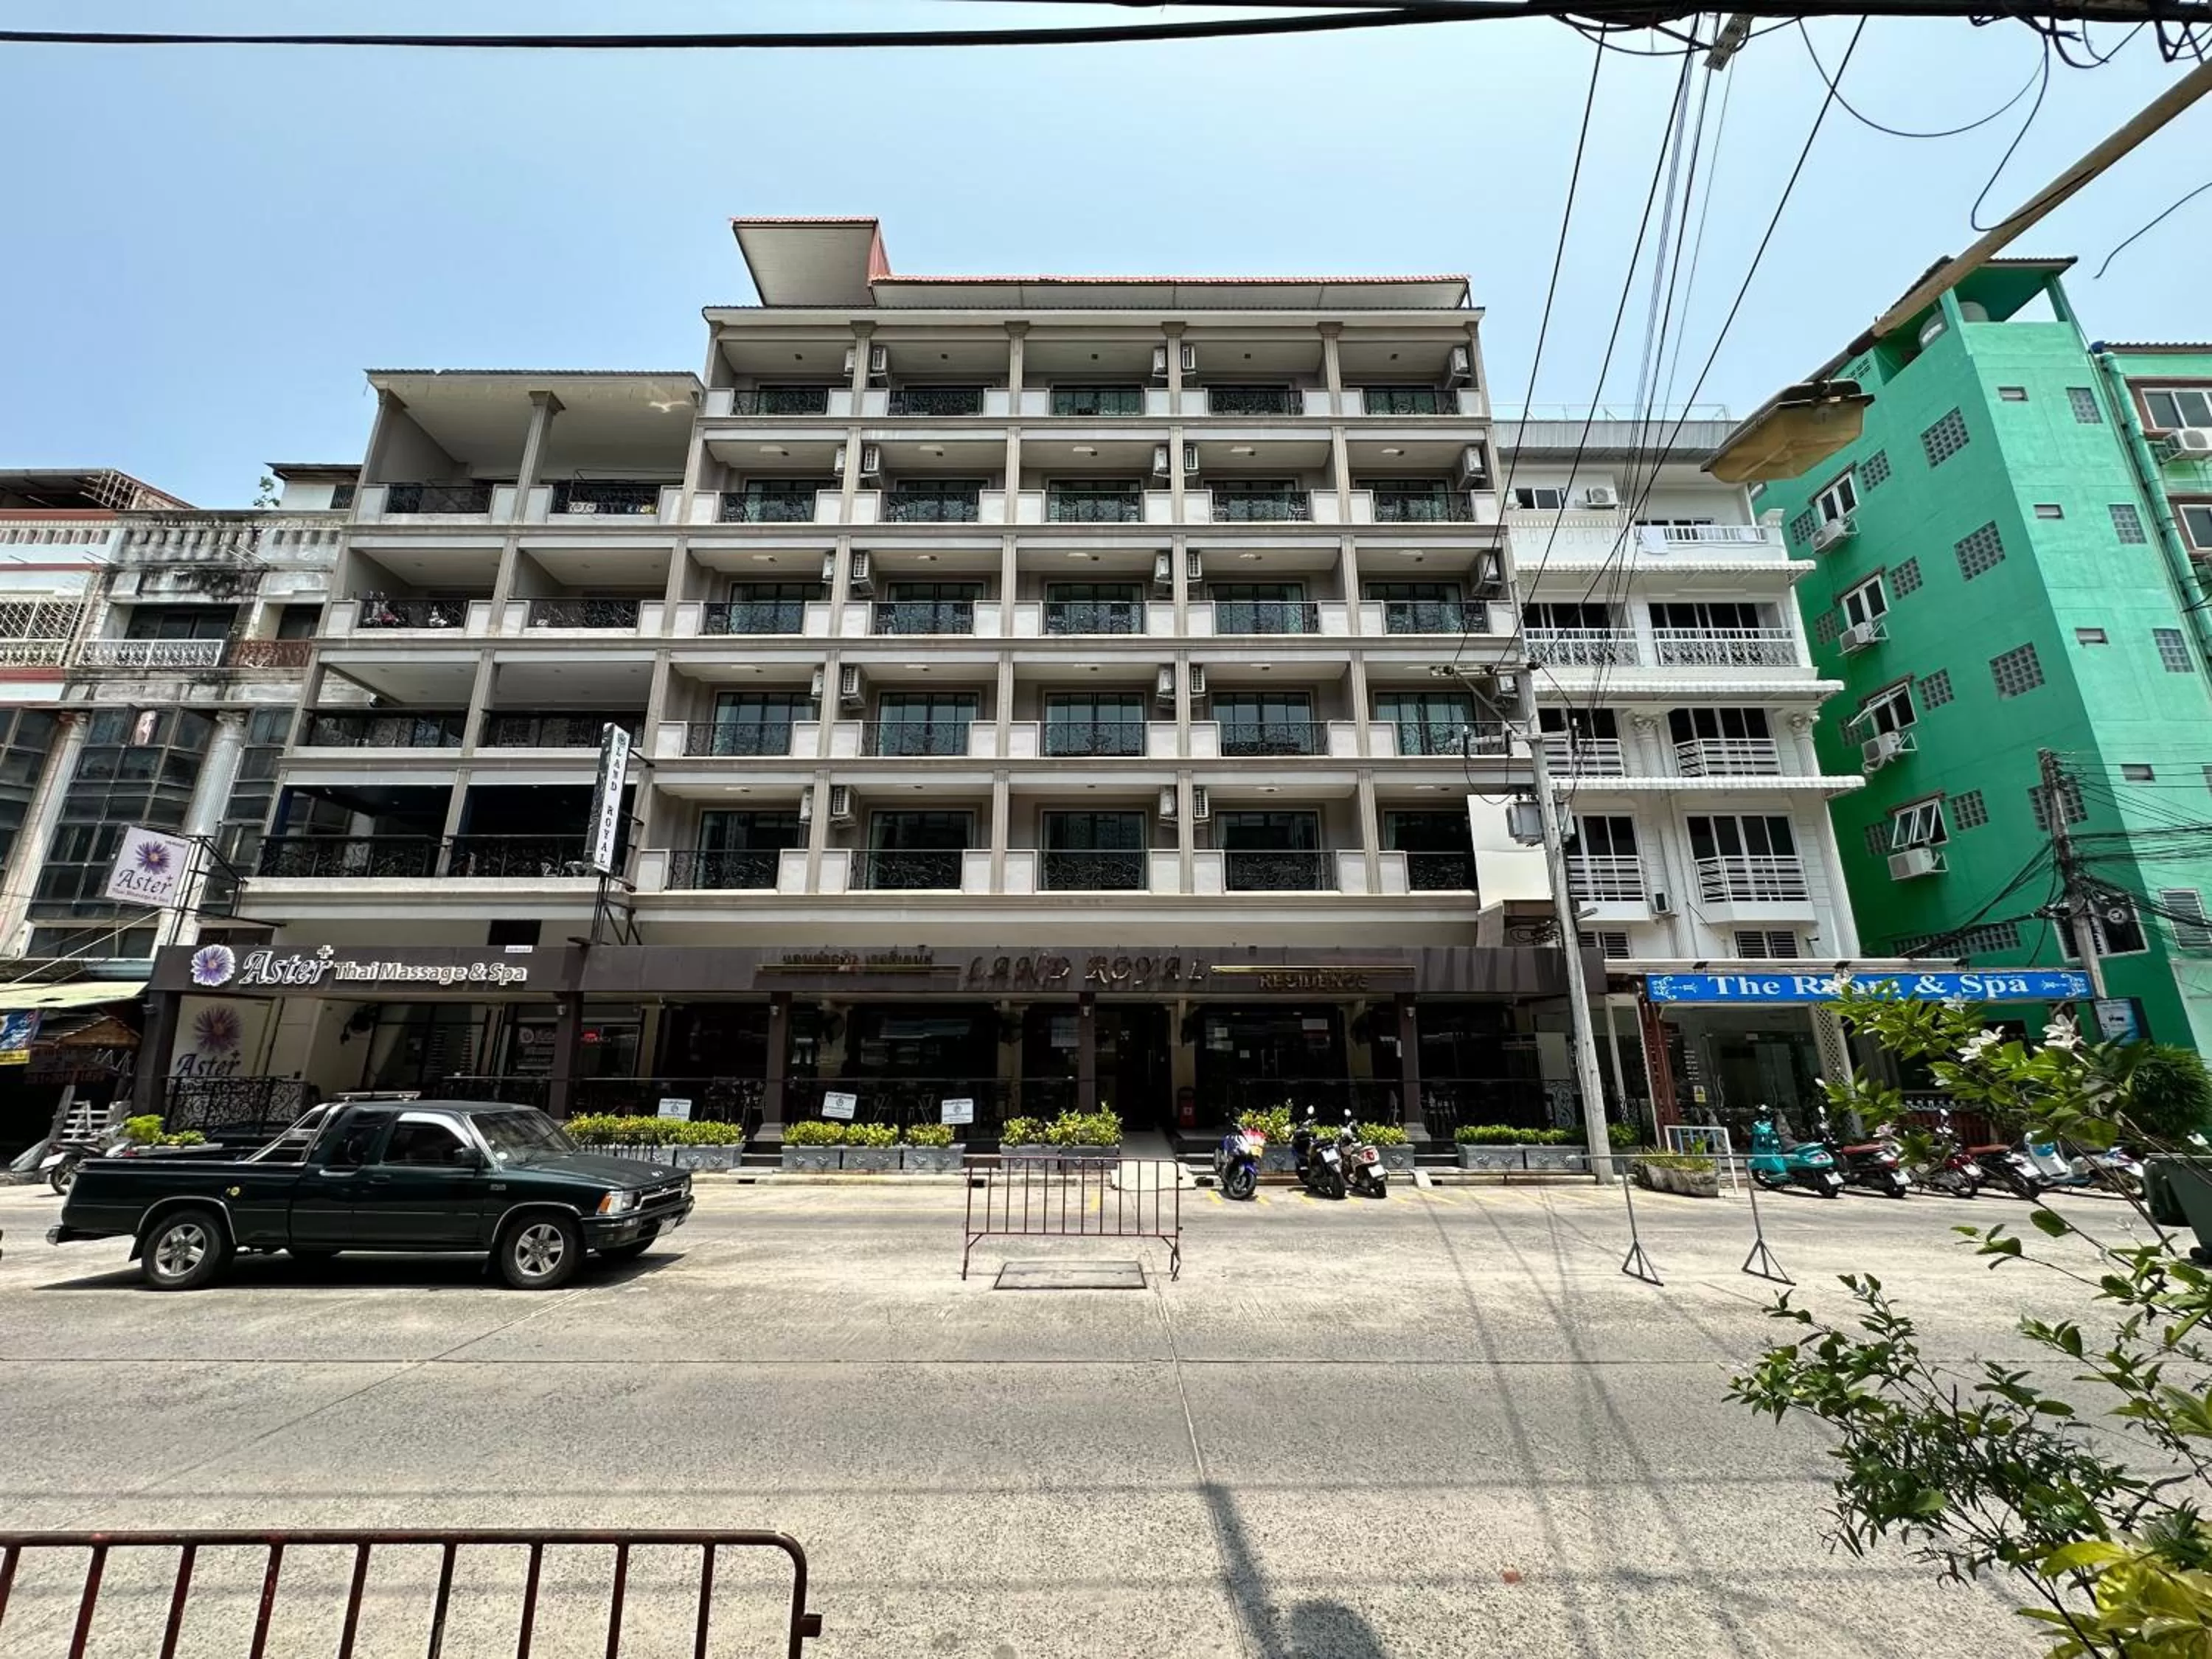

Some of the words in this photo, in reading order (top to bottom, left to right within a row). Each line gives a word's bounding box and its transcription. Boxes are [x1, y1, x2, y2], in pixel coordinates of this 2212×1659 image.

[334, 961, 379, 980] Thai
[380, 962, 468, 985] Massage
[469, 962, 488, 981] &
[488, 963, 528, 986] Spa
[1084, 956, 1207, 985] ROYAL
[1707, 975, 1781, 995] The
[1914, 975, 1947, 994] &
[1959, 974, 2030, 998] Spa
